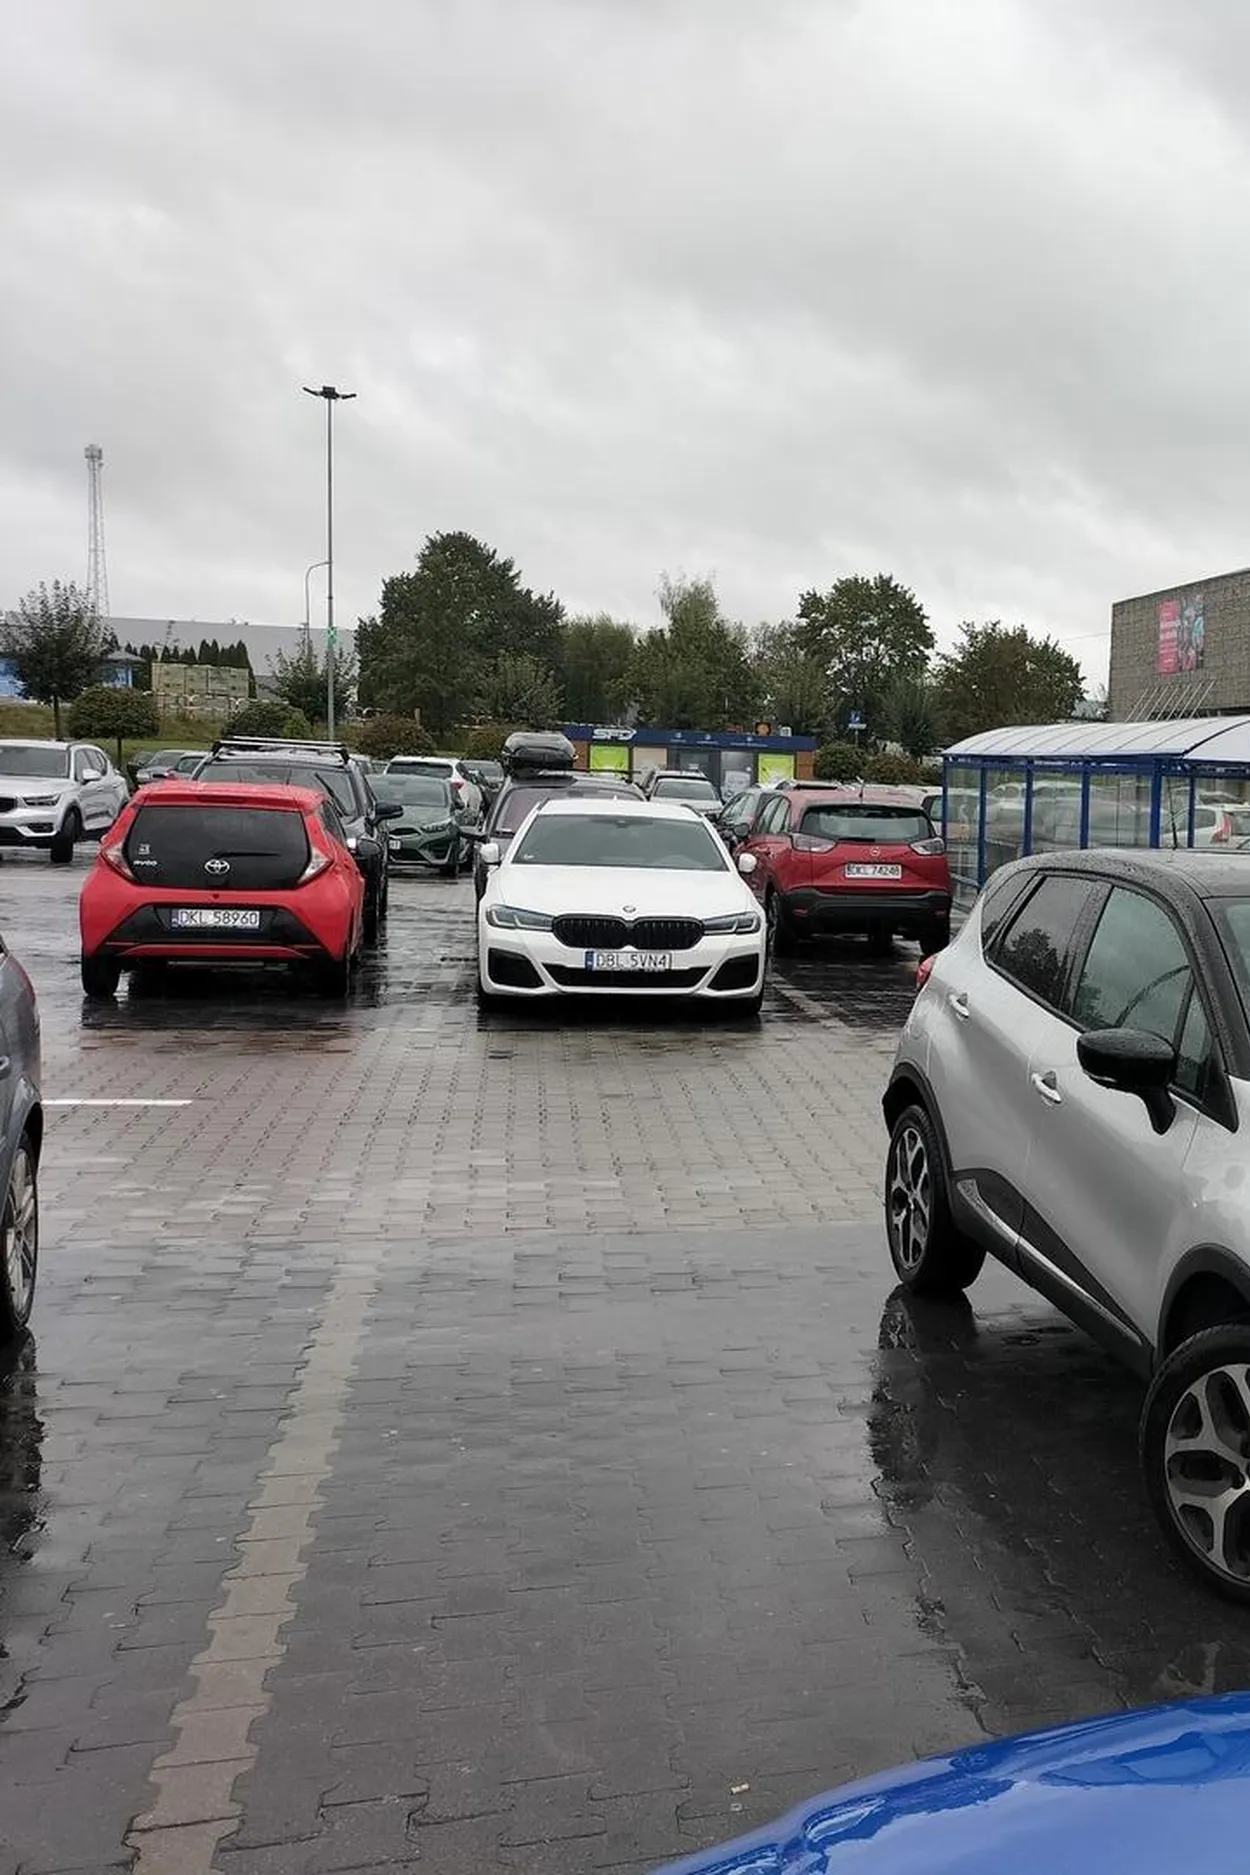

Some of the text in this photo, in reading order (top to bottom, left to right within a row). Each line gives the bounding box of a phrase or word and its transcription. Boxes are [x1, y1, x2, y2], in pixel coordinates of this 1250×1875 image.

[180, 910, 258, 926] DKL 58960
[596, 953, 667, 968] DBL 5VN4
